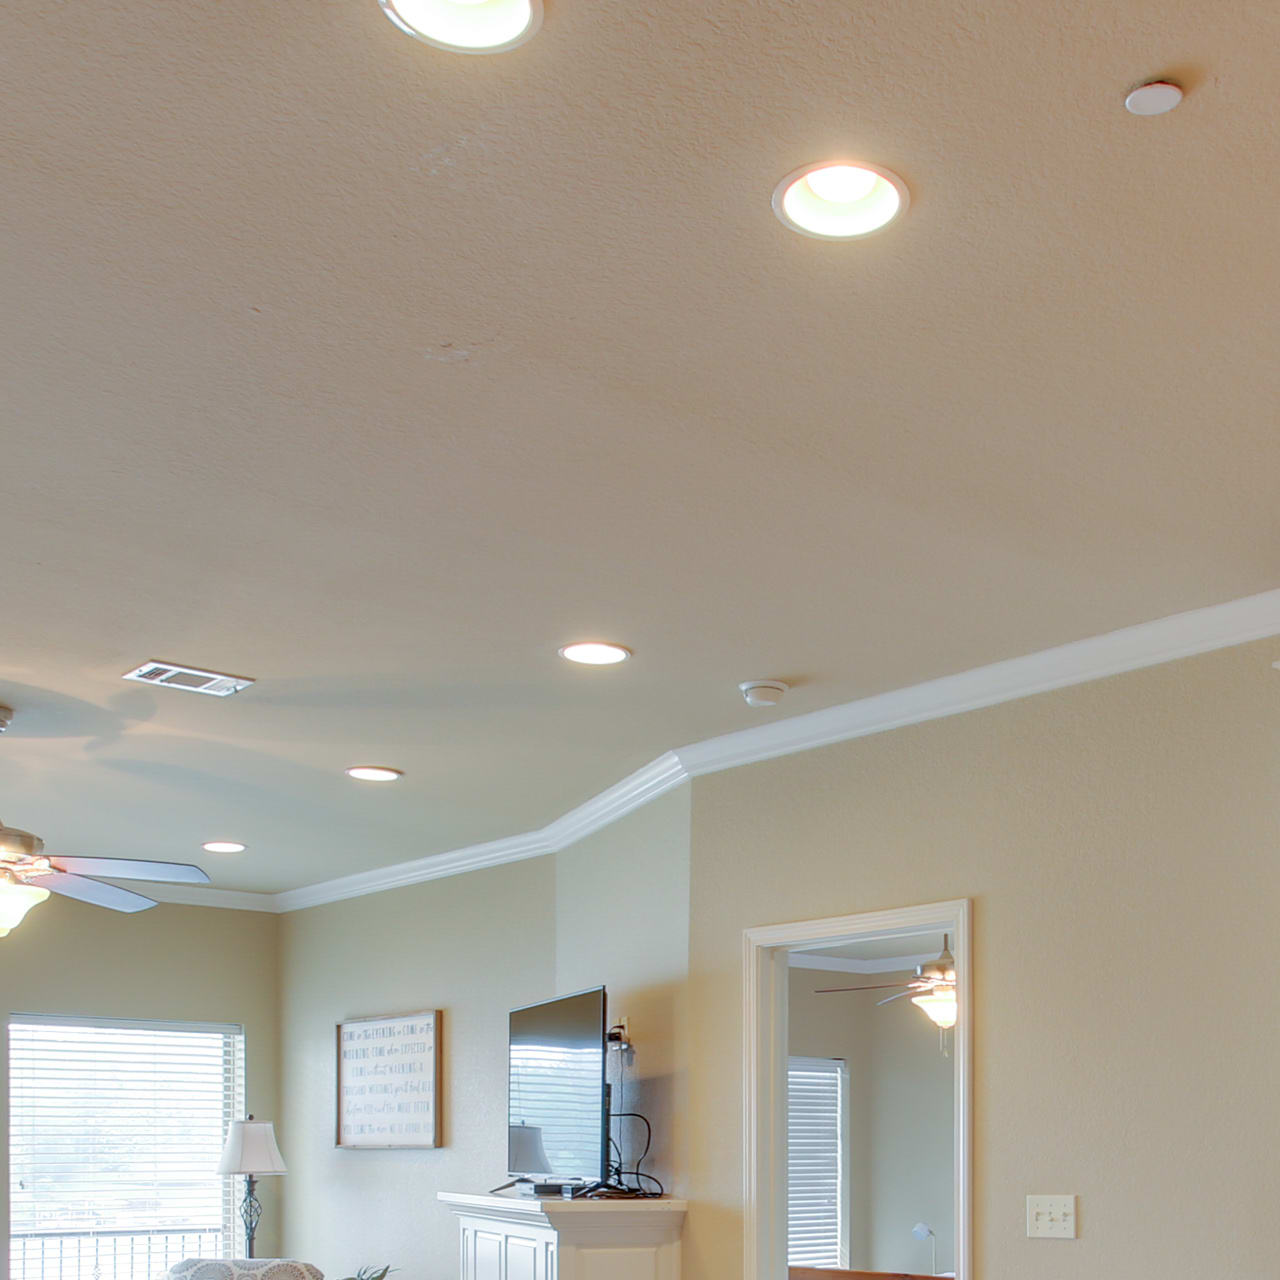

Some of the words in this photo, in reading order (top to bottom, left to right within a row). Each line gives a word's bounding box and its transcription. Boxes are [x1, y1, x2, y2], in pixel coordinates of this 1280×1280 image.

[372, 1026, 395, 1040] EVENING
[402, 1024, 417, 1036] COME
[343, 1048, 369, 1060] MORNING
[372, 1046, 385, 1057] COME
[401, 1042, 426, 1055] EXPECTED
